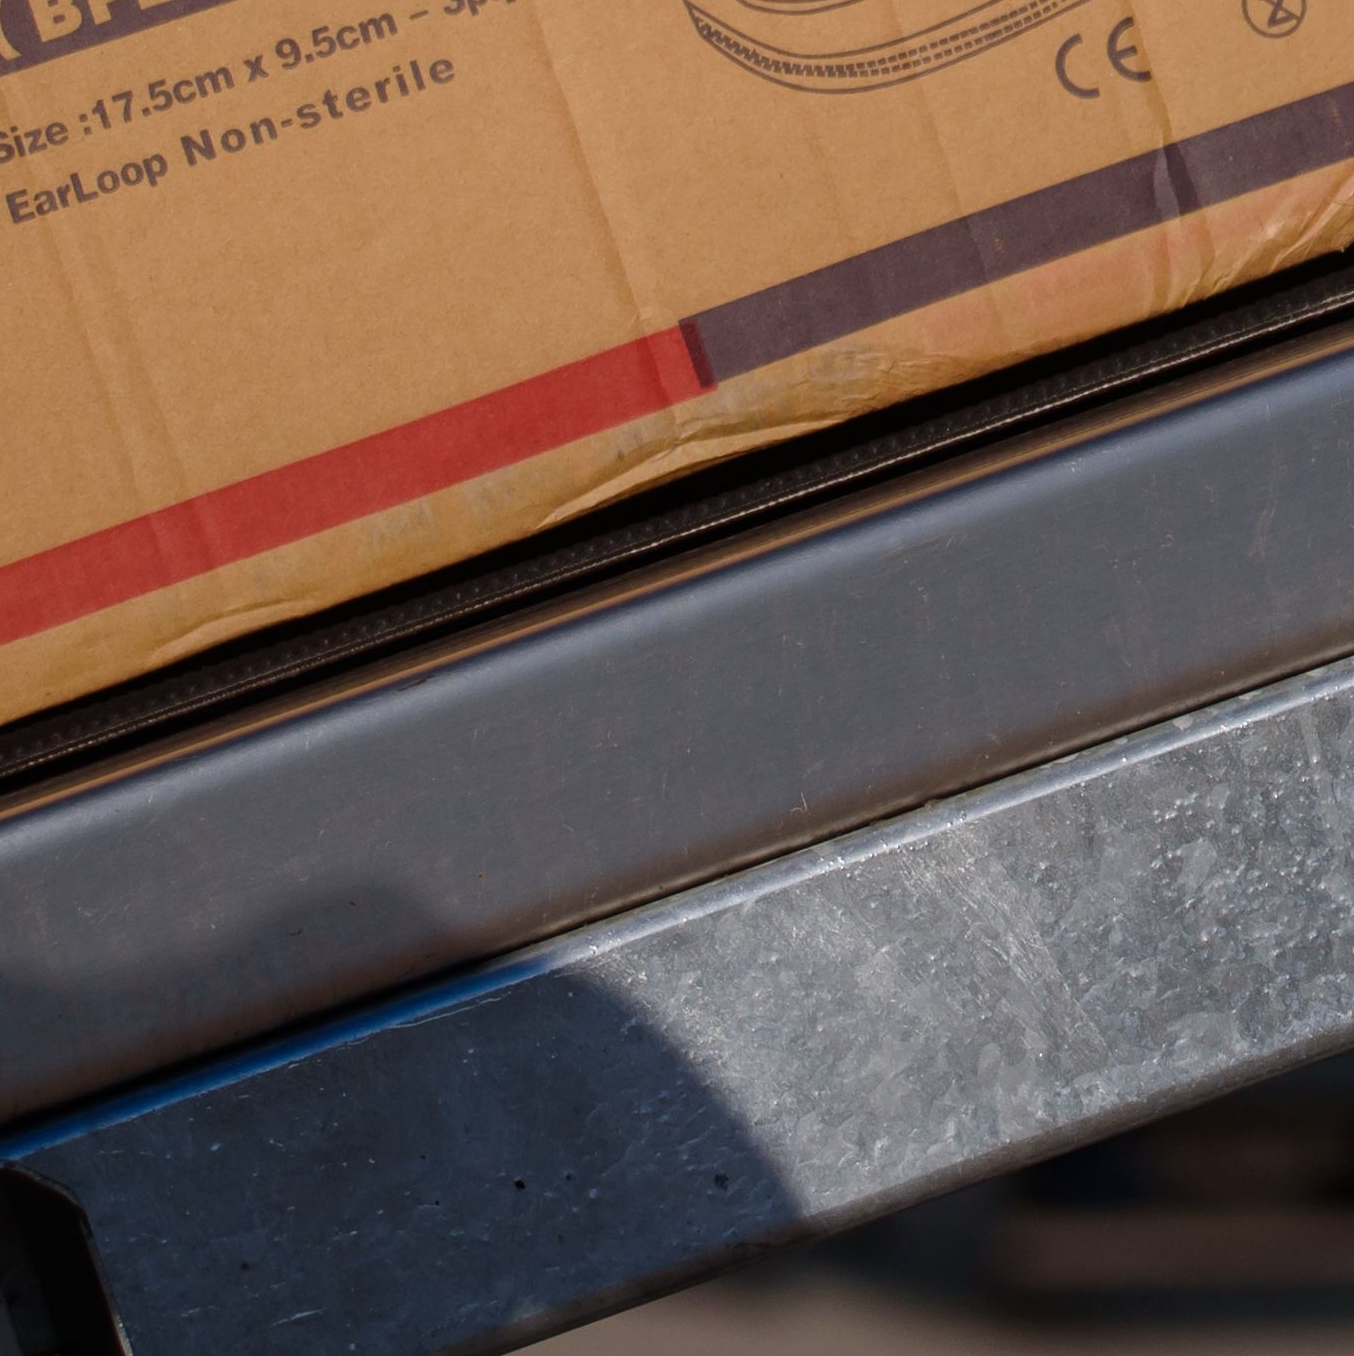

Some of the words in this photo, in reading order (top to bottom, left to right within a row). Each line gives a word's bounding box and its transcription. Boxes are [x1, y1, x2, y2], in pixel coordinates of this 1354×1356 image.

[245, 55, 267, 81] x
[273, 13, 397, 69] 9.5cm
[5, 152, 167, 224] EarLoop
[181, 59, 454, 166] Non-sterile
